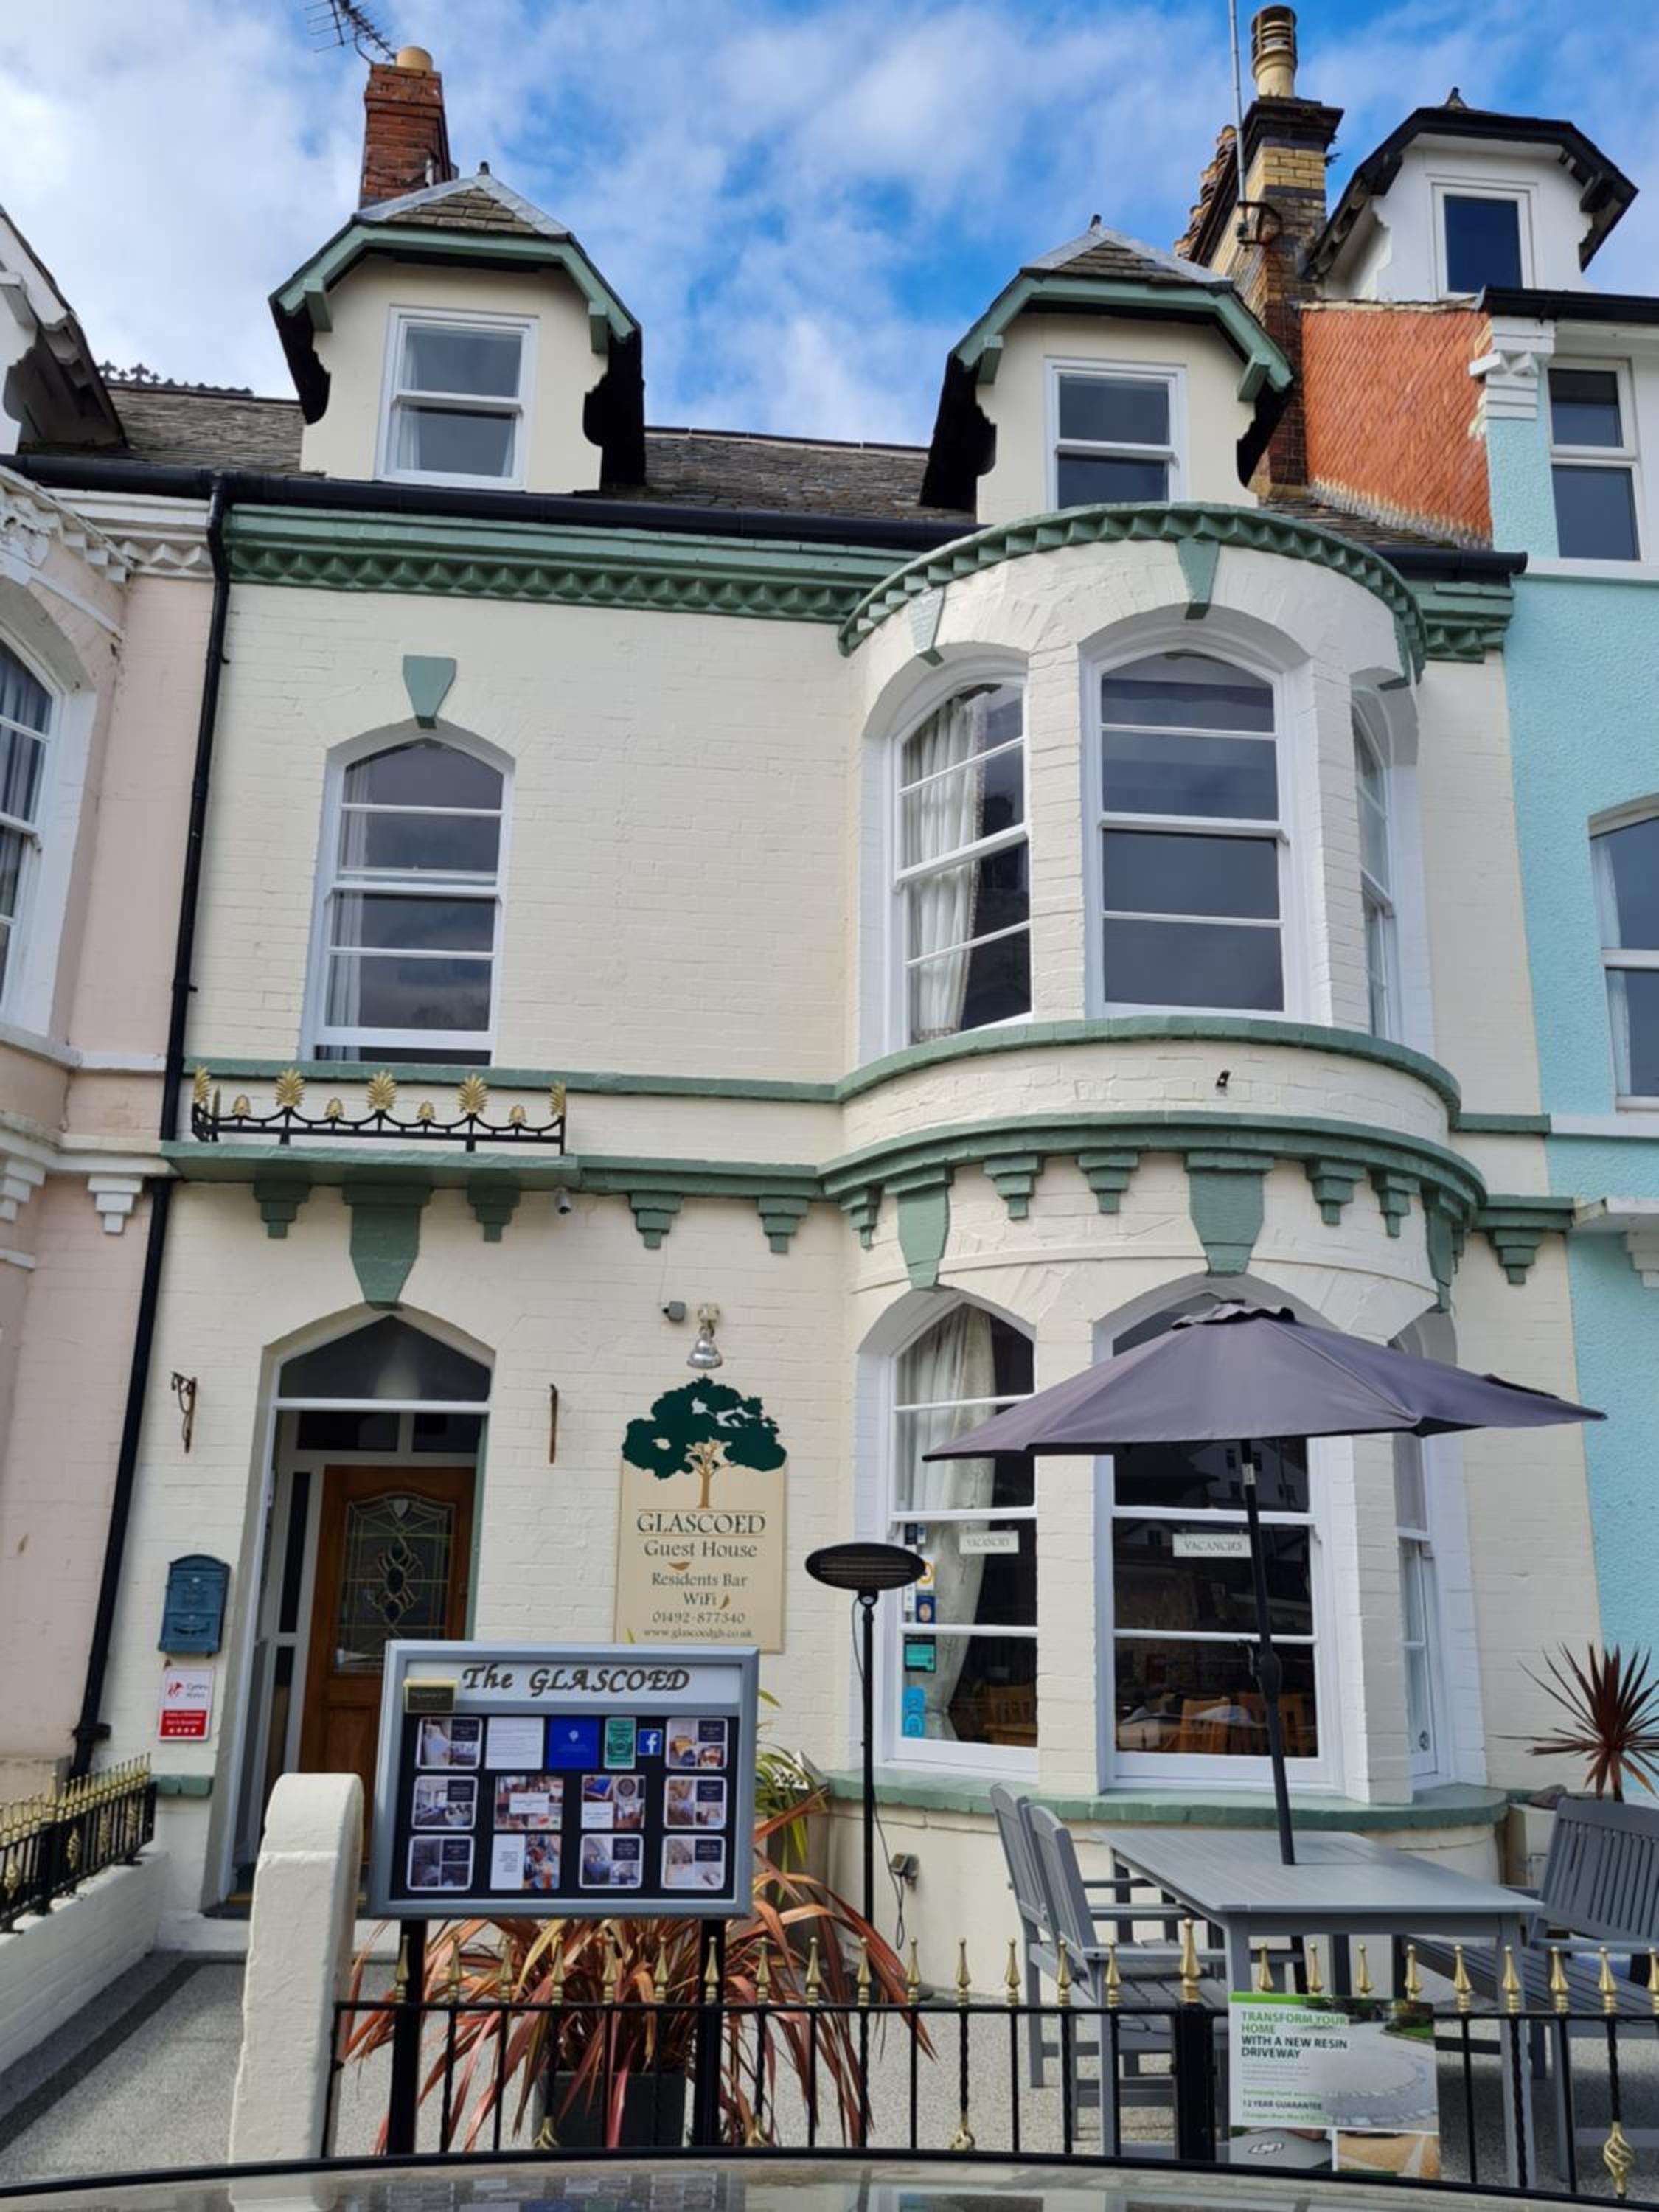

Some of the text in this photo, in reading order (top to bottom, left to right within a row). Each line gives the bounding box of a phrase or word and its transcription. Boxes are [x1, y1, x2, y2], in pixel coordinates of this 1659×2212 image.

[636, 1512, 766, 1534] GLASCOED
[644, 1540, 758, 1558] Guest House
[1183, 1540, 1243, 1552] VACANCIES
[651, 1571, 748, 1587] Residents Bar
[684, 1591, 717, 1606] WiFi
[462, 1663, 690, 1697] The GLASCOED
[1241, 2011, 1346, 2025] TRANSFORM YOUR
[1241, 2023, 1275, 2034] HOME
[1241, 2035, 1348, 2050] WITH A NEW RESIN
[1241, 2046, 1301, 2059] DRIVEWAY
[1253, 2100, 1273, 2108] YEAR
